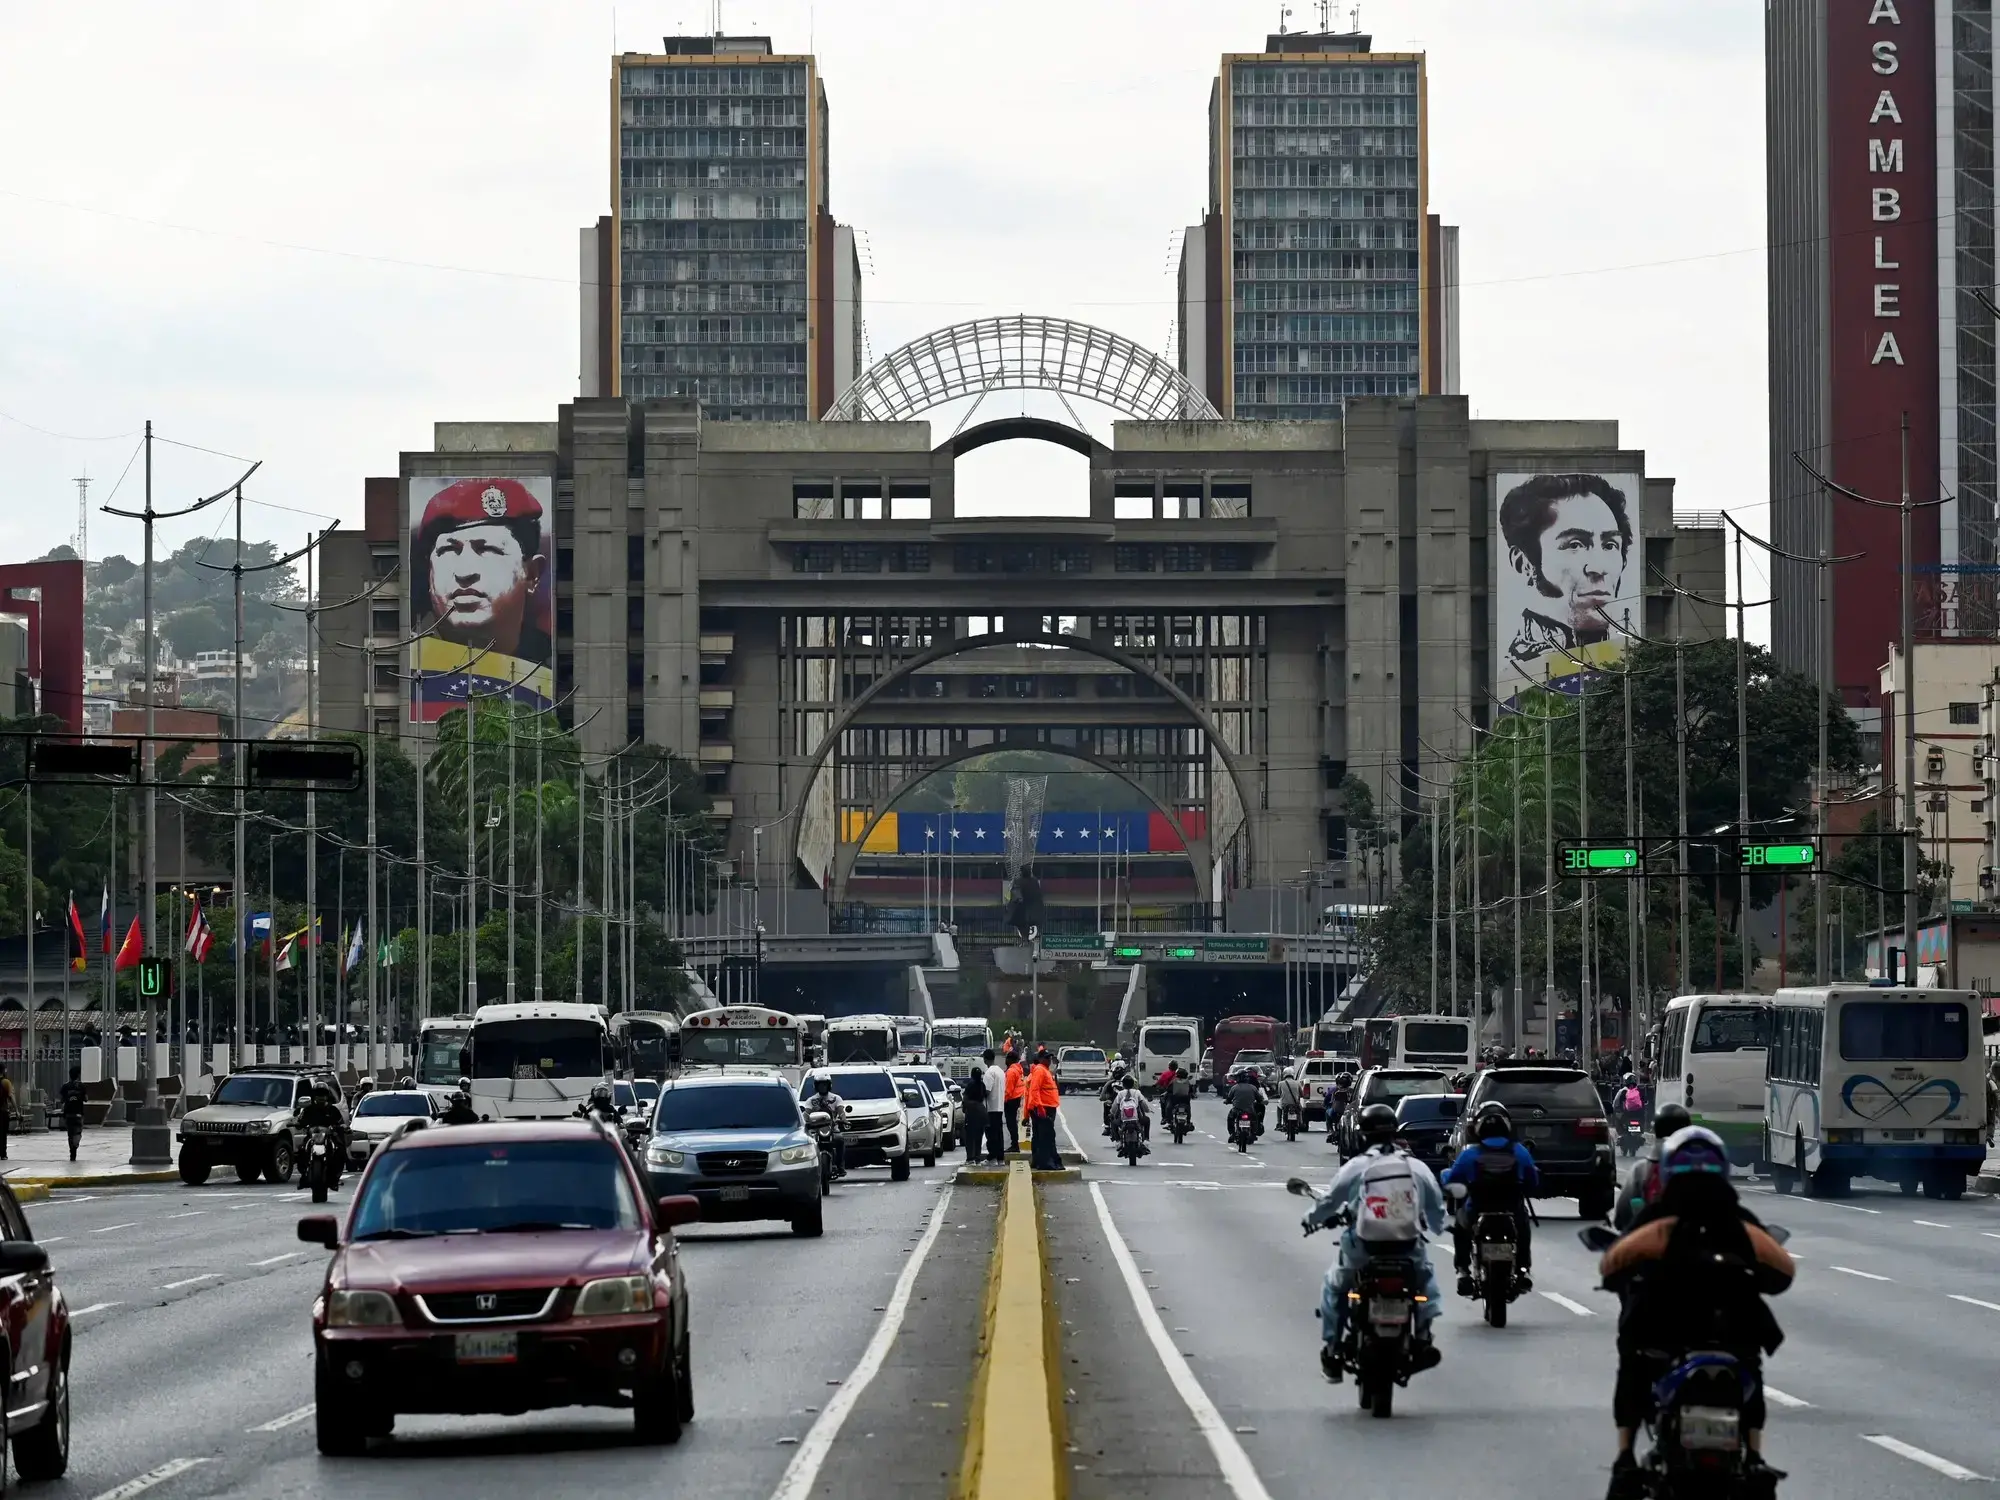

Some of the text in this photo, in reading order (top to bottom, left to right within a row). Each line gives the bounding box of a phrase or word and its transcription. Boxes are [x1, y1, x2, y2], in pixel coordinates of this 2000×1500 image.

[1867, 0, 1905, 366] ASAMBLEA
[1564, 850, 1588, 869] 38
[1742, 847, 1764, 866] 38
